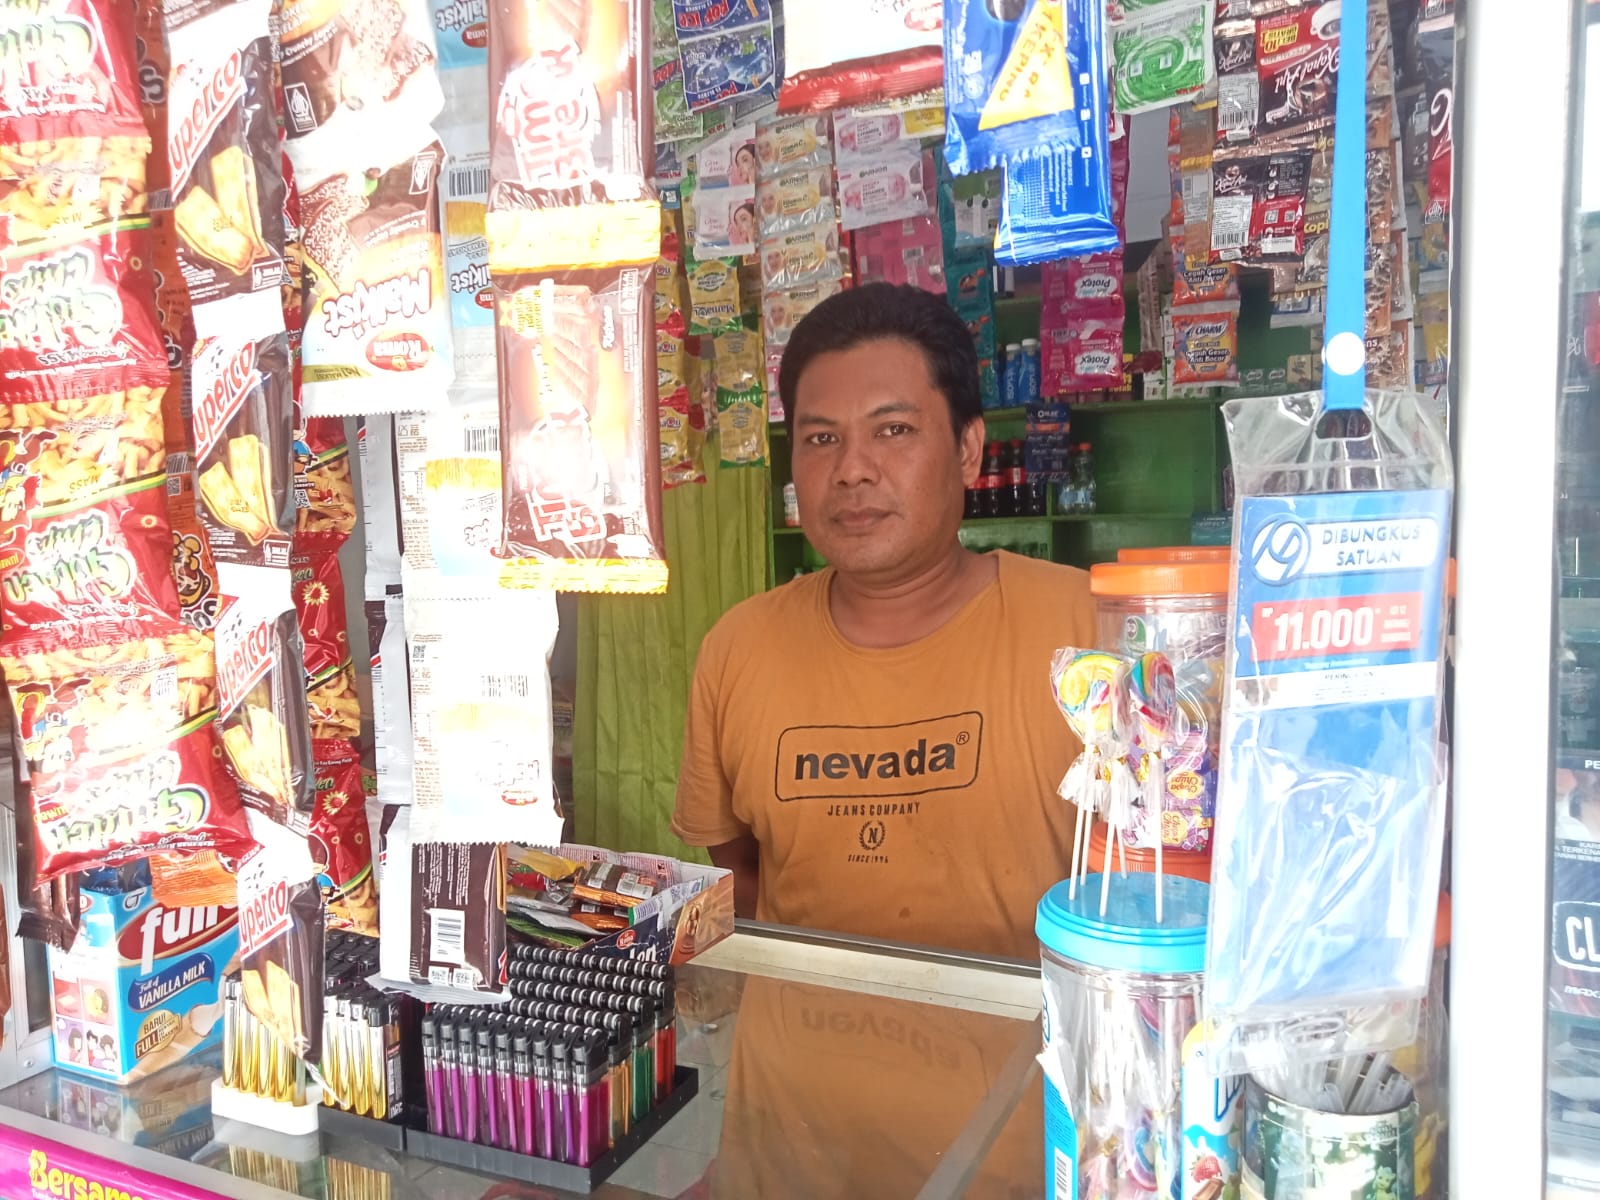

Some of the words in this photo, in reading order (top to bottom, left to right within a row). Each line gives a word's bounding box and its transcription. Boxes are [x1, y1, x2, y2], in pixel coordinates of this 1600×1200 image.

[436, 3, 487, 31] alkist
[170, 51, 240, 172] uperco
[321, 267, 431, 340] Malkist
[373, 340, 422, 361] Roma
[194, 341, 254, 439] uperco
[1322, 525, 1420, 546] DIBUNGKUS
[1336, 549, 1401, 567] SATUAN
[1273, 607, 1375, 652] 11.000
[215, 620, 269, 702] uperco
[795, 738, 956, 781] nevada
[827, 804, 866, 817] JEANS
[869, 801, 921, 816] COMPANY
[867, 827, 878, 844] N
[240, 880, 288, 951] uperco
[138, 975, 182, 1009] VANILLA
[182, 961, 206, 982] MILK
[143, 1012, 167, 1034] BARU!
[136, 1032, 159, 1058] FULL
[28, 1148, 147, 1200] Bersam
